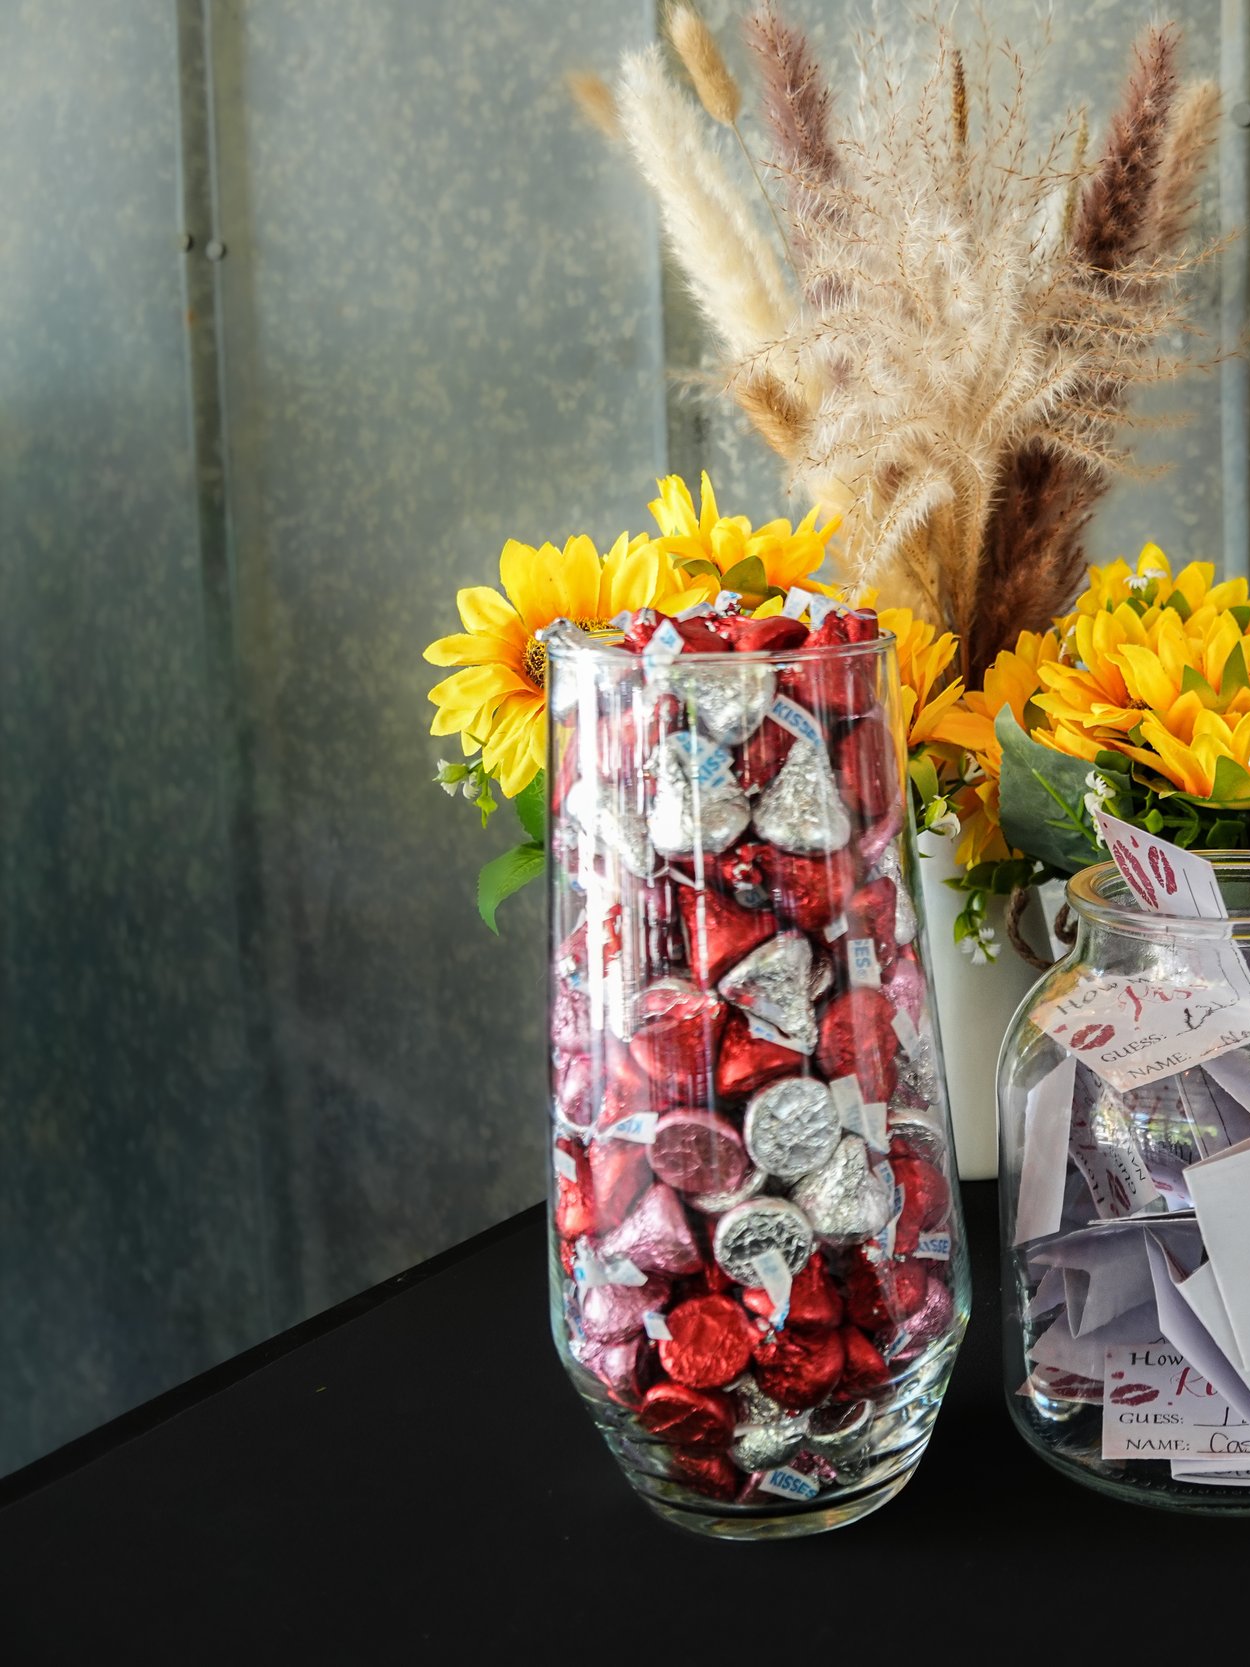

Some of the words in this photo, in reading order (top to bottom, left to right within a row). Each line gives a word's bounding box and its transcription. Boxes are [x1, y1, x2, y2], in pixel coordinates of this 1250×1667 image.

[1100, 1033, 1168, 1063] GUESS:
[1127, 1051, 1193, 1079] NAME:
[1129, 1352, 1183, 1366] How
[1119, 1412, 1184, 1425] GUESS:
[1126, 1438, 1190, 1451] NAME:
[769, 1470, 817, 1499] KISSES
